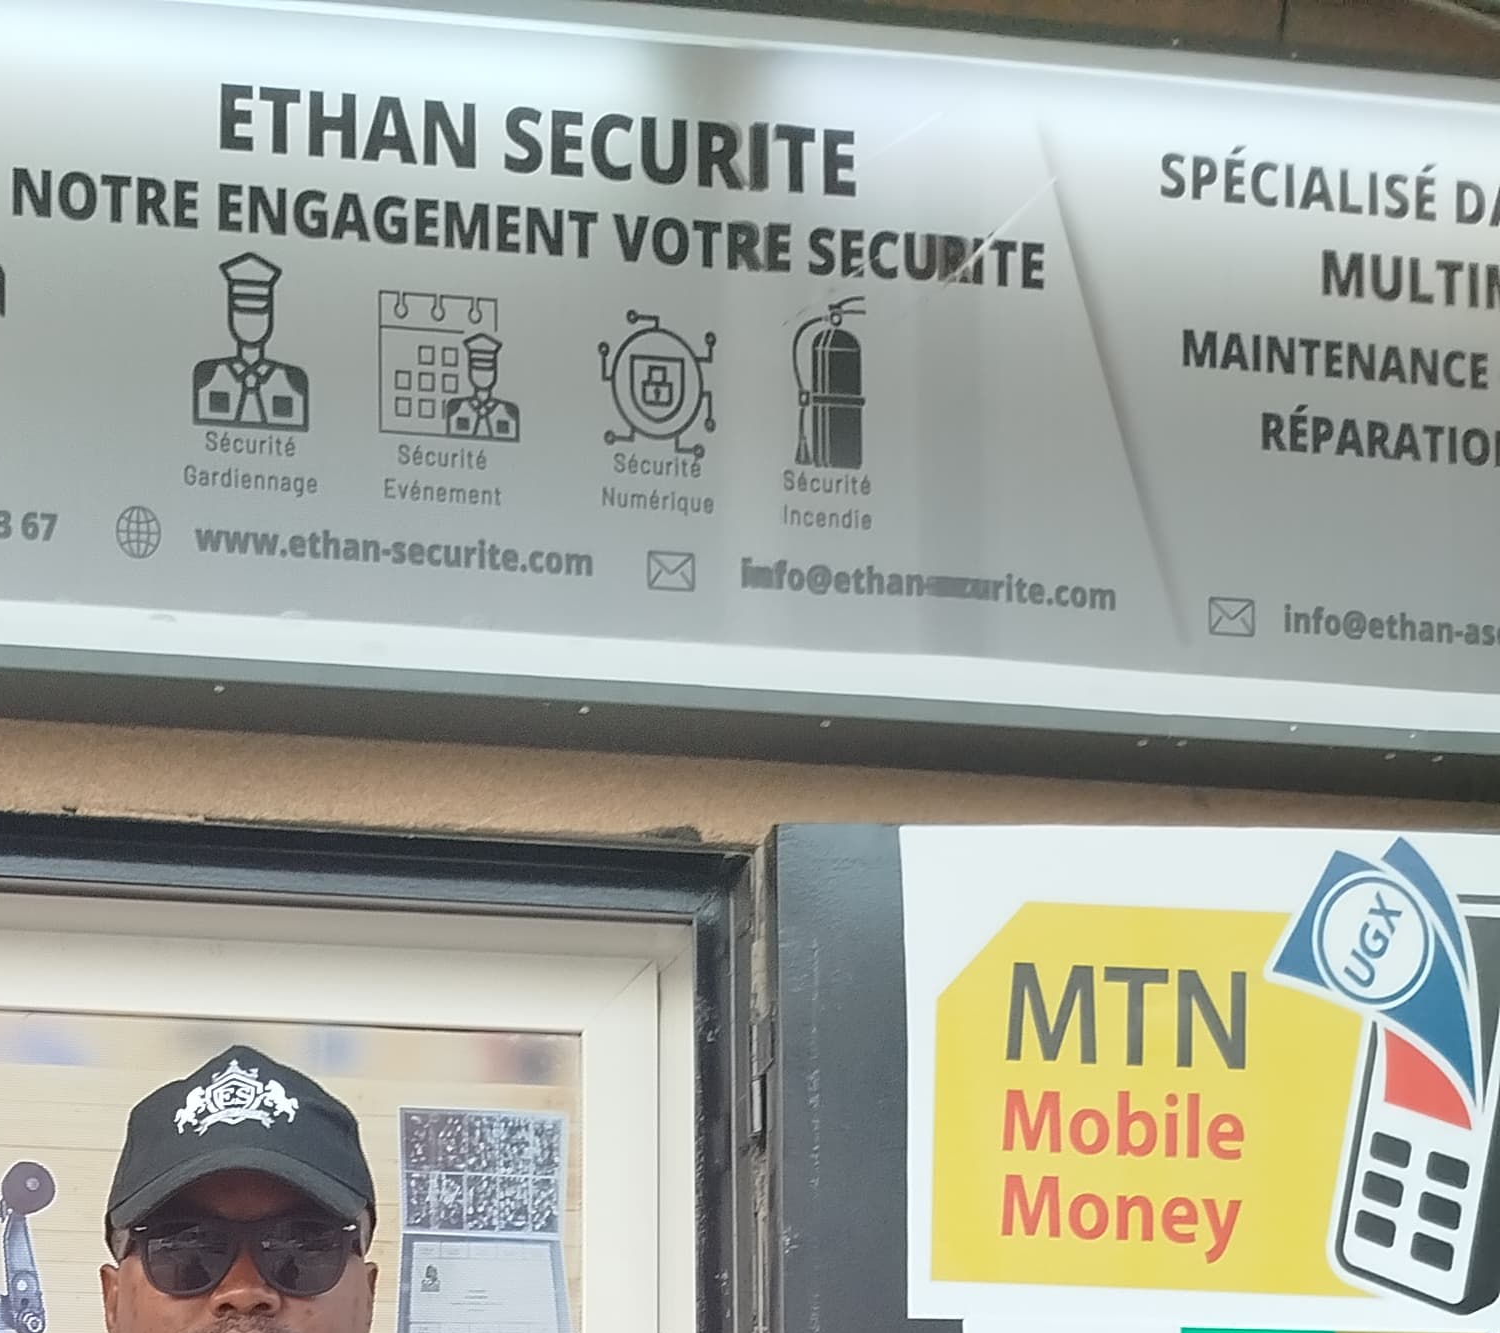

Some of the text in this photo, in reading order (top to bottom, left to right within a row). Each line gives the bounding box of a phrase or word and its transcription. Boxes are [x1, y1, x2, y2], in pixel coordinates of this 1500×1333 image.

[219, 82, 858, 196] ETHAN SECURITE
[1160, 144, 1437, 221] SPÉCIALISÉ
[12, 166, 1046, 291] NOTRE ENGAGEMENT VOTRE SECURITE
[1182, 328, 1489, 391] MAINTENANCE
[205, 430, 296, 459] Sécurité
[397, 443, 489, 472] Sécurité
[613, 450, 702, 479] Sécurité
[182, 464, 318, 498] Gardiennage
[383, 476, 504, 508] Evénement
[601, 486, 714, 517] Numérique
[783, 468, 872, 497] Sécurité
[20, 510, 58, 541] 67
[783, 505, 873, 531] Incendie
[195, 526, 593, 580] www.ethan-securite.com
[1343, 891, 1403, 989] UGX
[1005, 961, 1247, 1070] MTN
[1001, 1089, 1244, 1160] Mobile
[1001, 1174, 1242, 1264] Money
